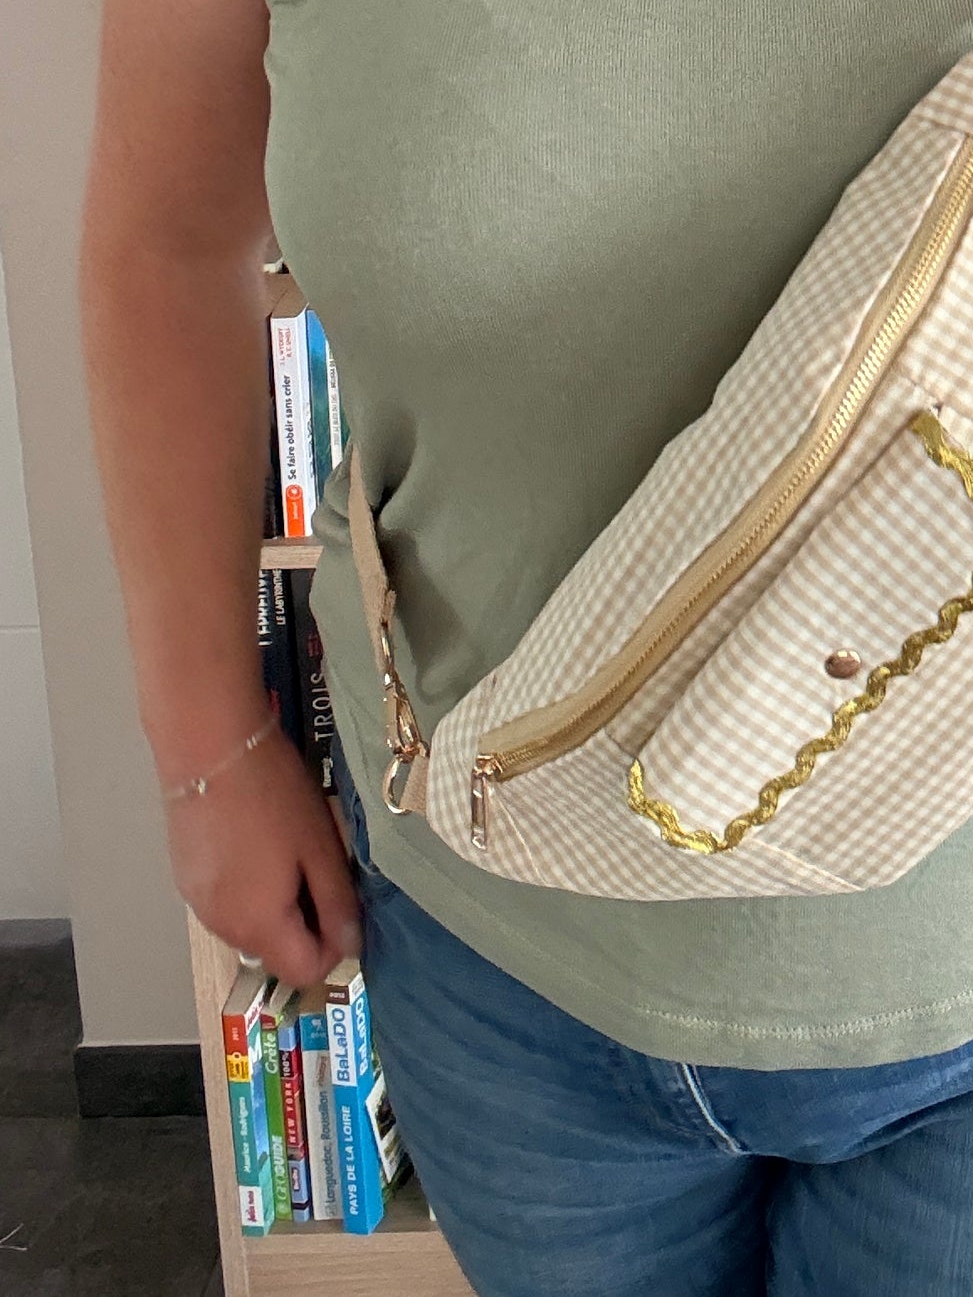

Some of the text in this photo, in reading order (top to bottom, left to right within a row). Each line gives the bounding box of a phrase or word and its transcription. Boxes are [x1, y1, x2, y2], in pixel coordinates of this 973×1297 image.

[282, 375, 297, 480] Se faire obéir sans crier
[277, 615, 286, 625] LE
[310, 672, 334, 742] TROIS
[331, 1007, 351, 1082] BaLaDO
[284, 1082, 297, 1143] NEW YORK
[341, 1105, 360, 1215] PAYS DE LA LOIRE
